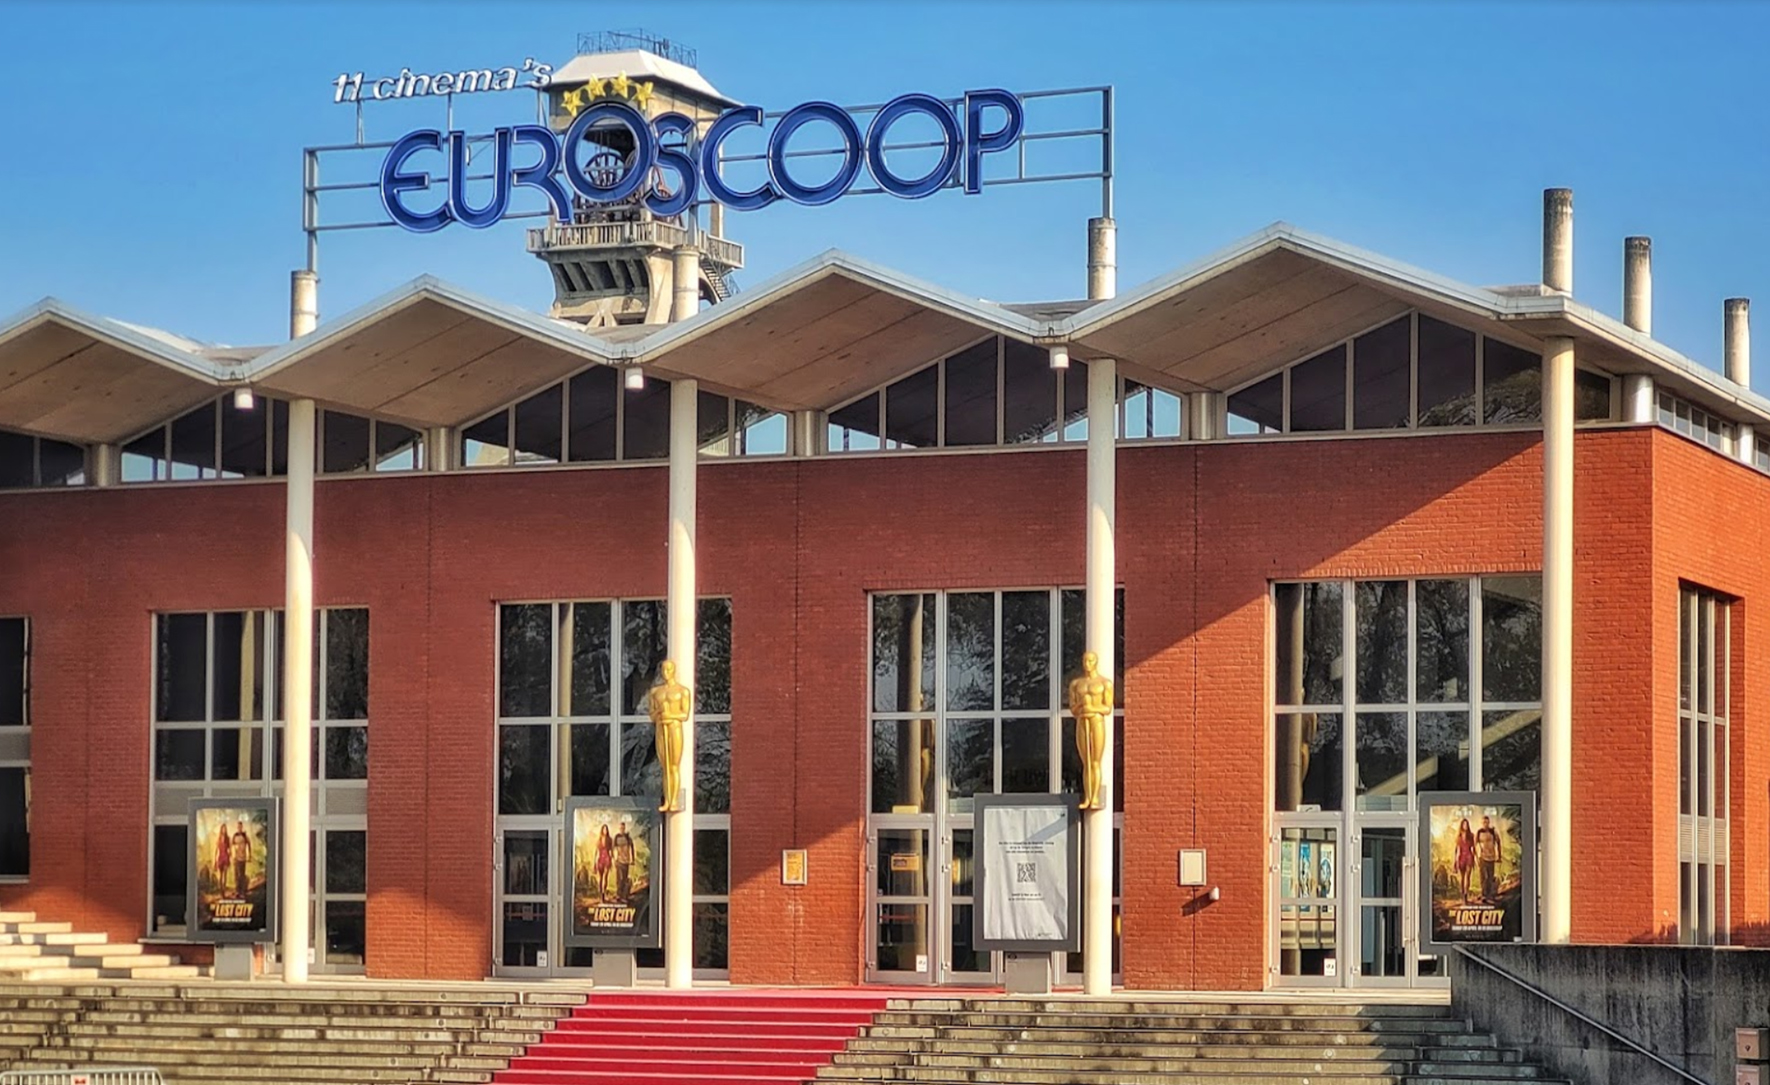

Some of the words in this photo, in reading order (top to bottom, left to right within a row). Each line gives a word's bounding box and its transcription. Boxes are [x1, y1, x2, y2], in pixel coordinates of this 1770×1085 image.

[372, 57, 553, 100] cinema's
[379, 88, 1024, 234] EUROSCOOP
[593, 908, 615, 921] LOST
[615, 908, 636, 921] CITY
[1456, 910, 1482, 925] LOST
[1481, 910, 1505, 925] CITY
